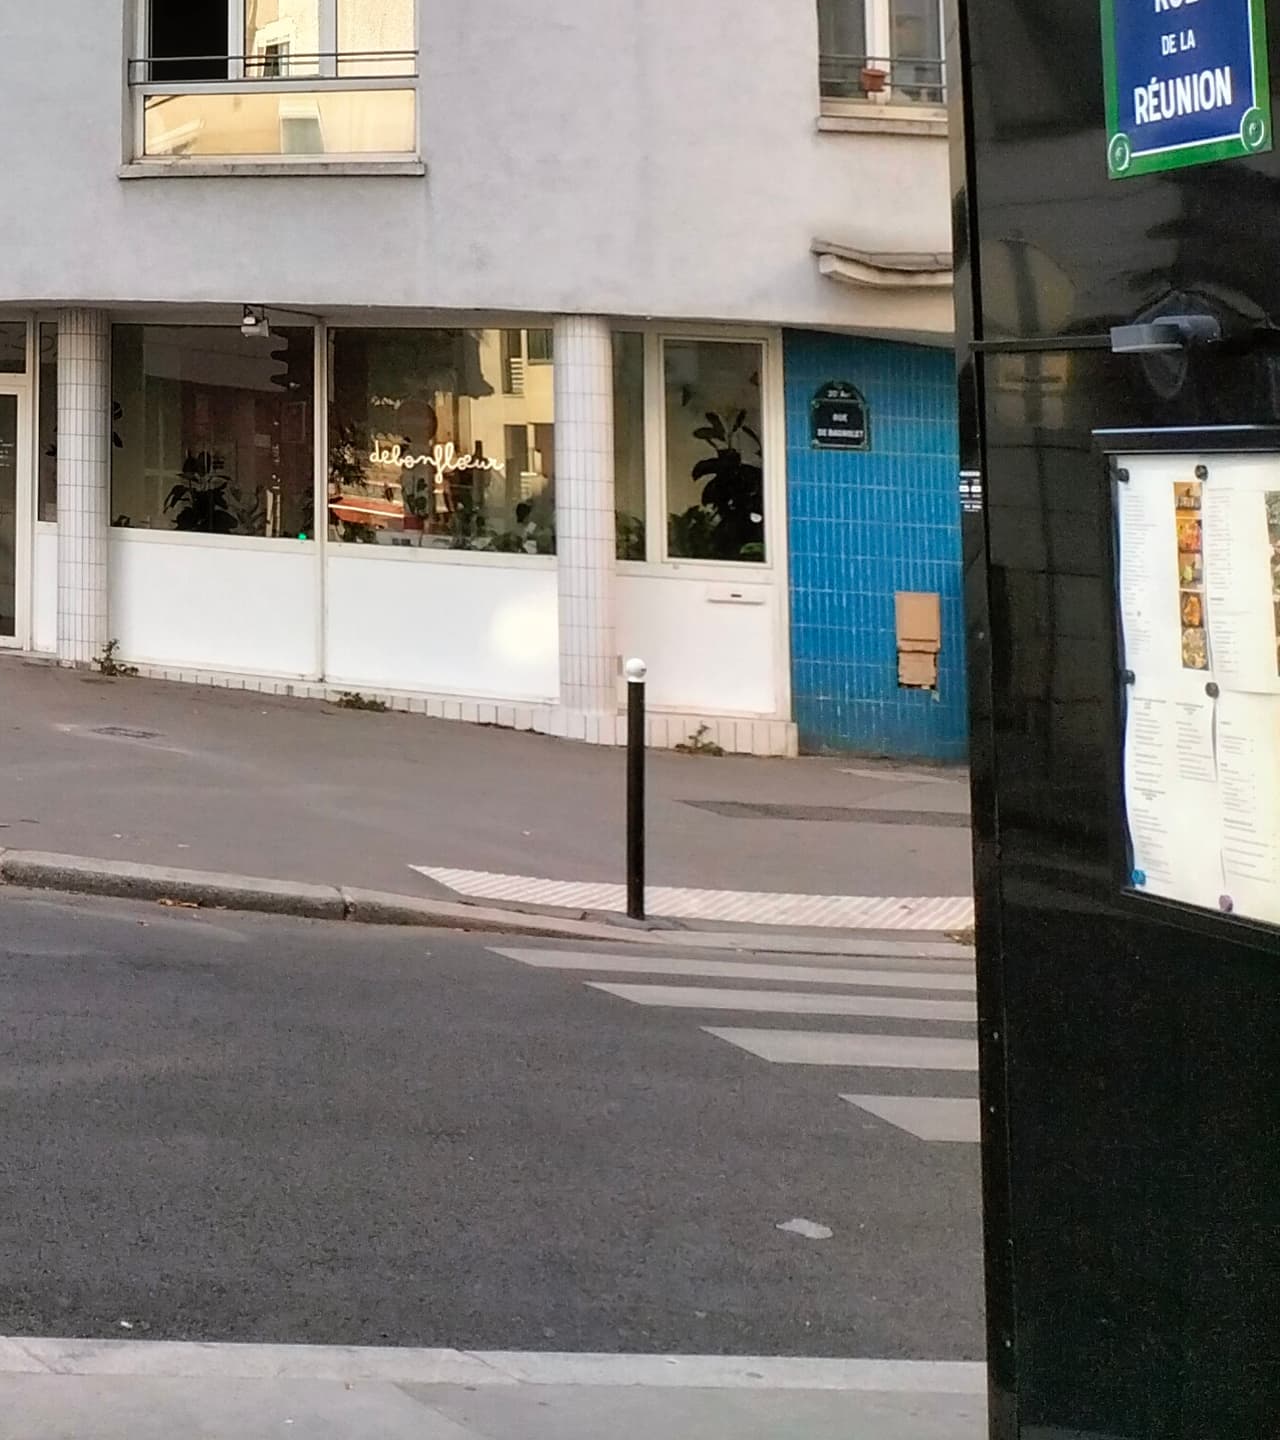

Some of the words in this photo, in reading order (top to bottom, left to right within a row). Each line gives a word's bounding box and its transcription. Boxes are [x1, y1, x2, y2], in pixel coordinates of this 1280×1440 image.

[1161, 35, 1176, 56] DE
[1180, 29, 1196, 50] LA
[1133, 65, 1232, 125] RÉUNION
